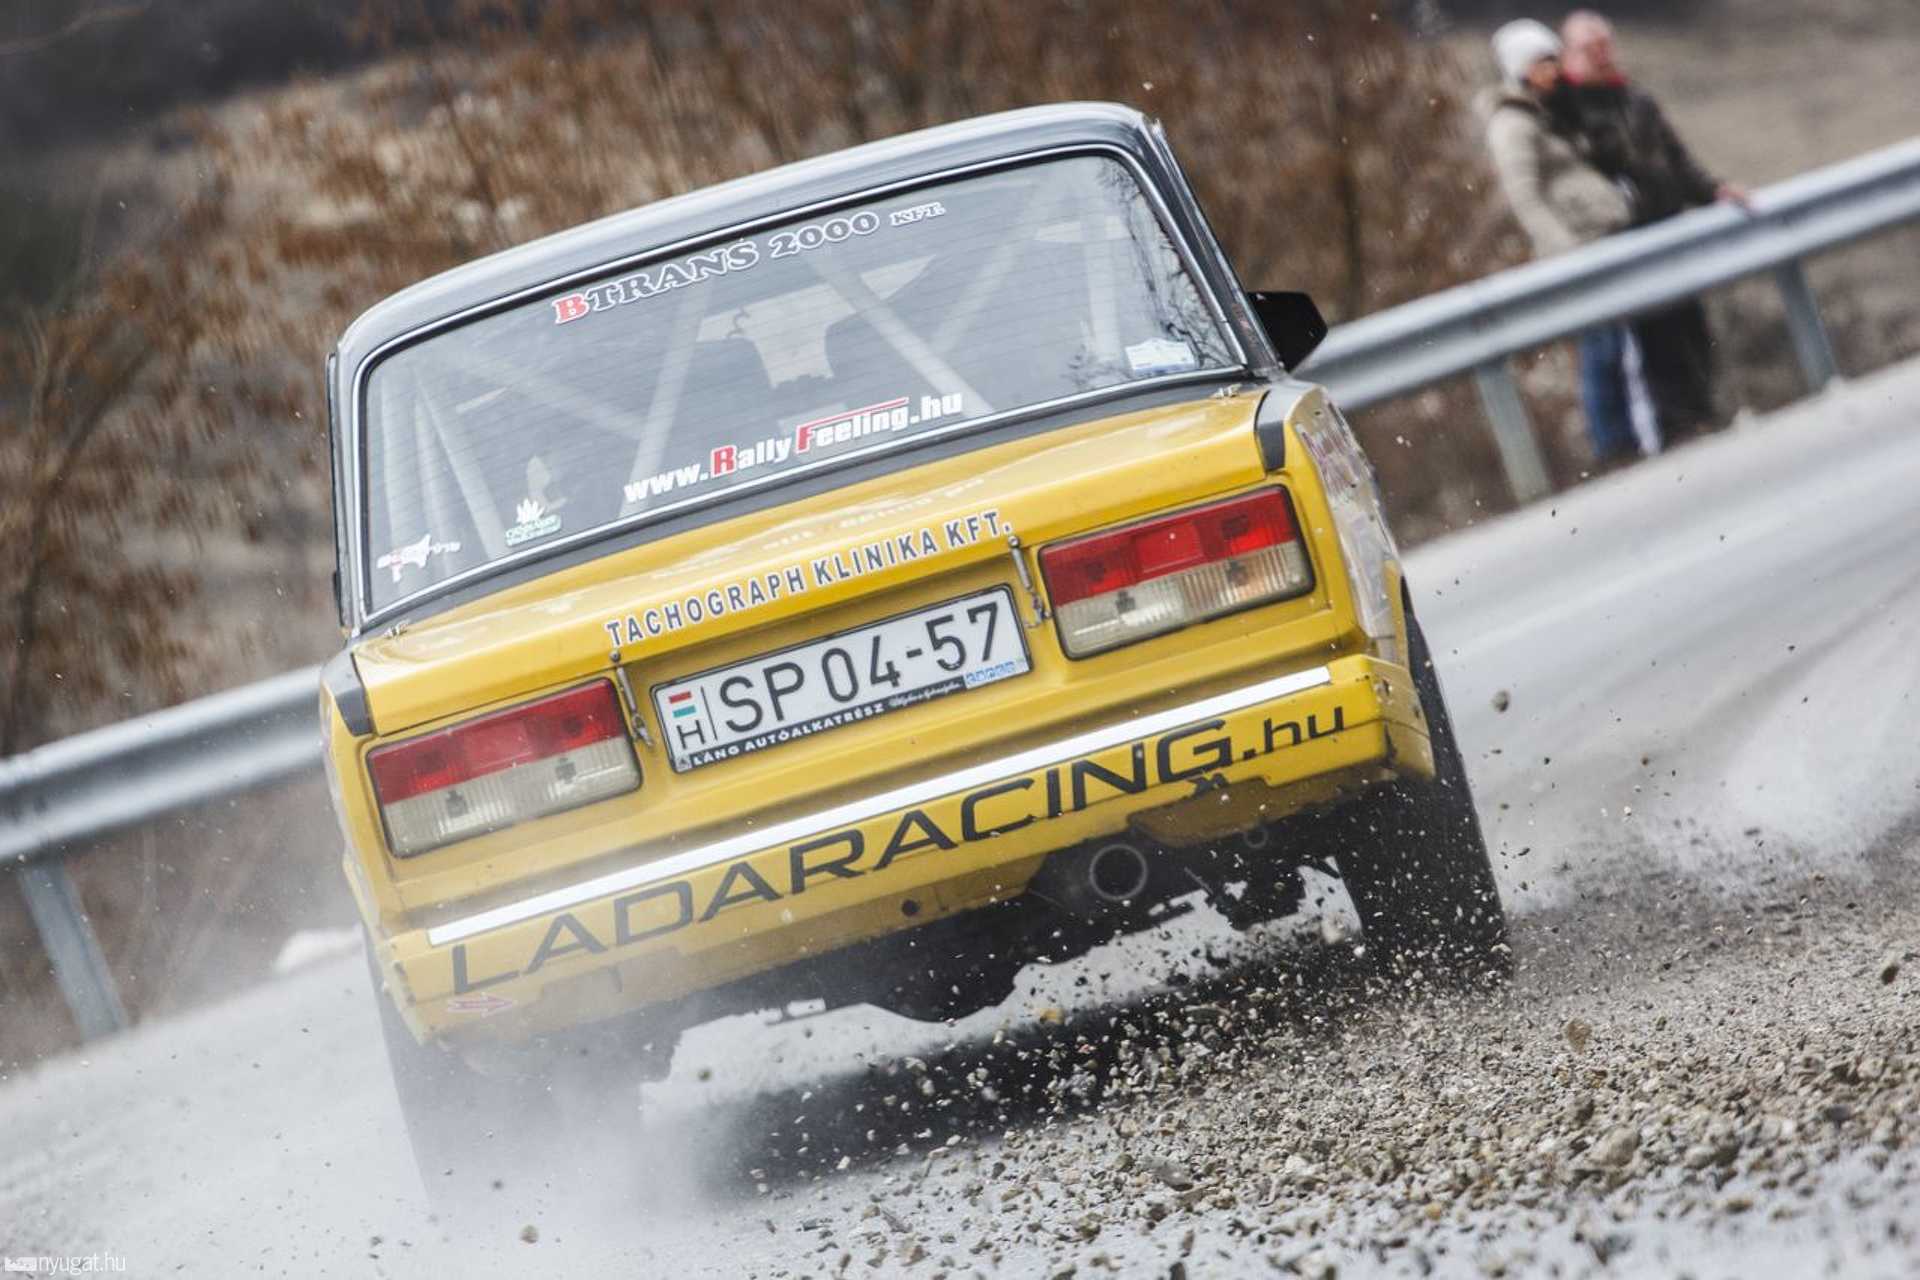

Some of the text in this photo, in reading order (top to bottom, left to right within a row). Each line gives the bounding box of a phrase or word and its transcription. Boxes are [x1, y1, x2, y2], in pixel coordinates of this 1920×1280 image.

[552, 239, 759, 324] BTRANS
[769, 211, 880, 258] 2000
[607, 511, 1012, 647] TACHOGRAPH KLINIKA KFT.
[676, 720, 705, 750] H
[450, 706, 1345, 995] LADARACING.hu
